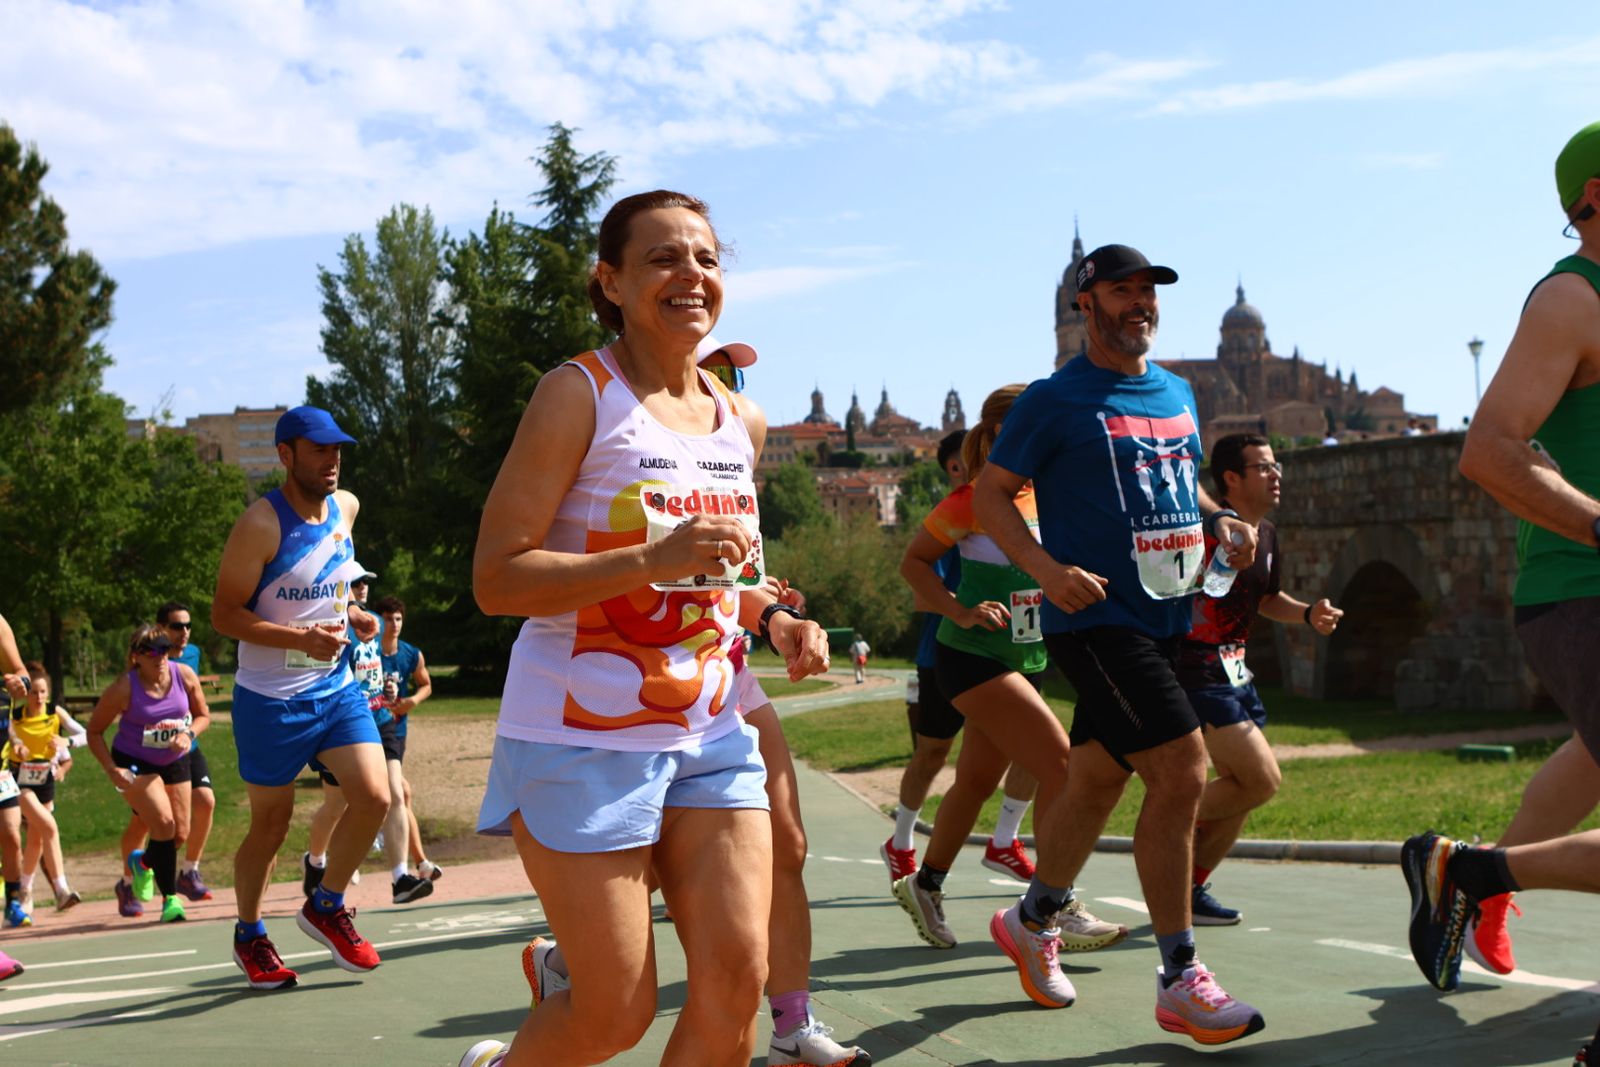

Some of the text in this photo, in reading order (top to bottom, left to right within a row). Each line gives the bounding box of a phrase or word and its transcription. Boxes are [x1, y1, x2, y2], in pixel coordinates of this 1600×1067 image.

[639, 457, 679, 470] ALMUDENA
[1174, 550, 1185, 579] 1
[1024, 607, 1040, 630] 1
